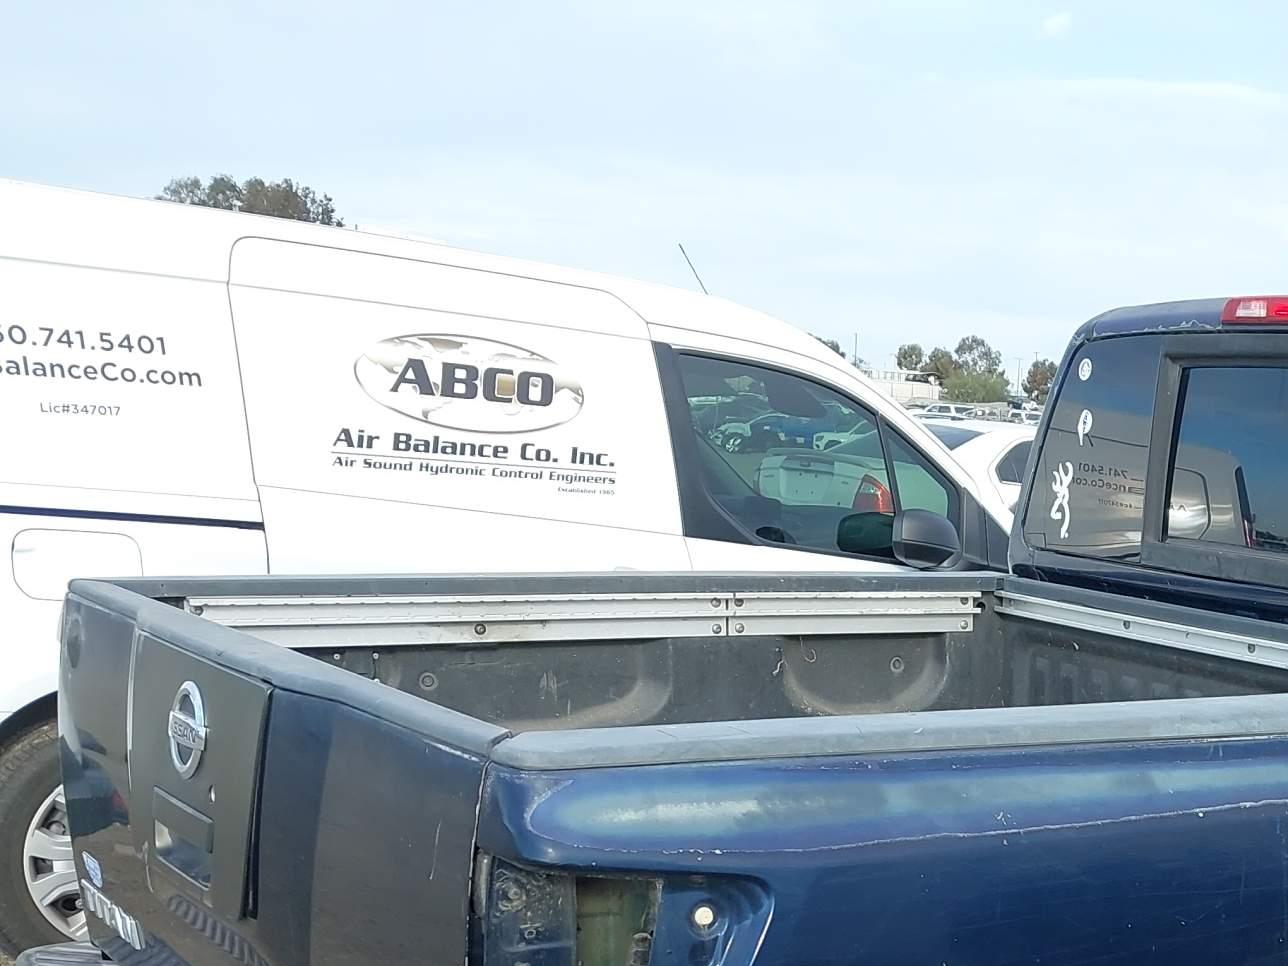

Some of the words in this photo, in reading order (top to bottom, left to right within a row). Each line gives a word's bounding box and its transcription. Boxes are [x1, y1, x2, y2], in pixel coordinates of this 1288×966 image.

[0, 324, 167, 356] 0.741.5401
[0, 355, 203, 387] alanceCo.com
[389, 357, 555, 408] ABCO
[40, 402, 121, 416] Lic#347017
[333, 427, 380, 449] Air
[392, 432, 509, 460] Balance
[520, 443, 559, 463] Co.
[570, 446, 616, 468] Inc.
[332, 456, 357, 468] Air
[362, 458, 413, 472] Sound
[419, 462, 486, 476] Hydronic
[492, 467, 543, 481] Control
[549, 471, 616, 486] Engineers
[81, 878, 147, 950] TITAN
